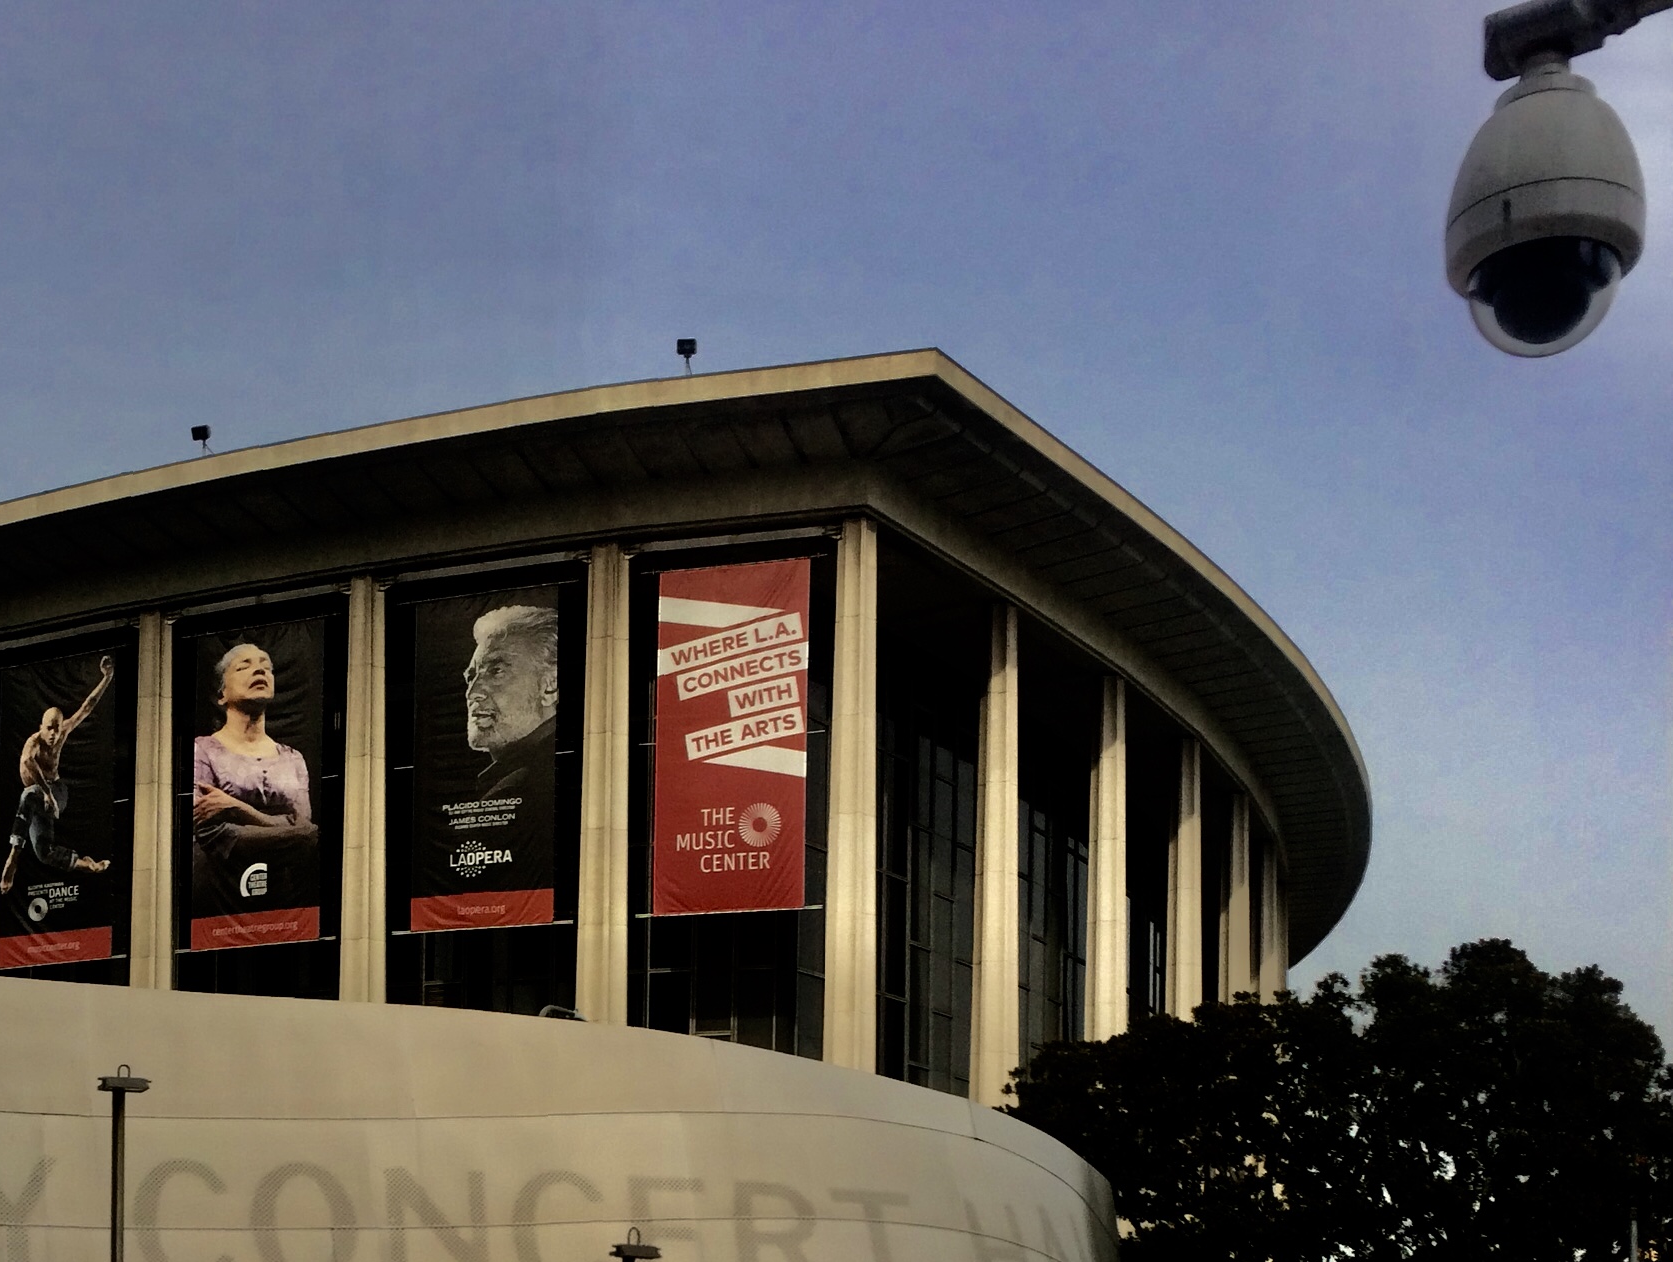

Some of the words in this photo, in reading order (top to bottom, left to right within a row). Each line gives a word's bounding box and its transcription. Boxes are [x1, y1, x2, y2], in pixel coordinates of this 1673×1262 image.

[671, 631, 749, 666] WHERE
[754, 621, 798, 644] L.A.
[683, 649, 802, 693] CONNECTS
[734, 683, 793, 710] WITH
[691, 728, 734, 753] THE
[740, 713, 797, 741] ARTS
[480, 797, 523, 808] DOMINGO
[448, 816, 477, 826] JAMES
[477, 813, 516, 823] CONLON
[700, 806, 736, 827] THE
[676, 829, 736, 852] MUSIC
[700, 851, 771, 874] CENTER
[49, 885, 79, 898] DANCE
